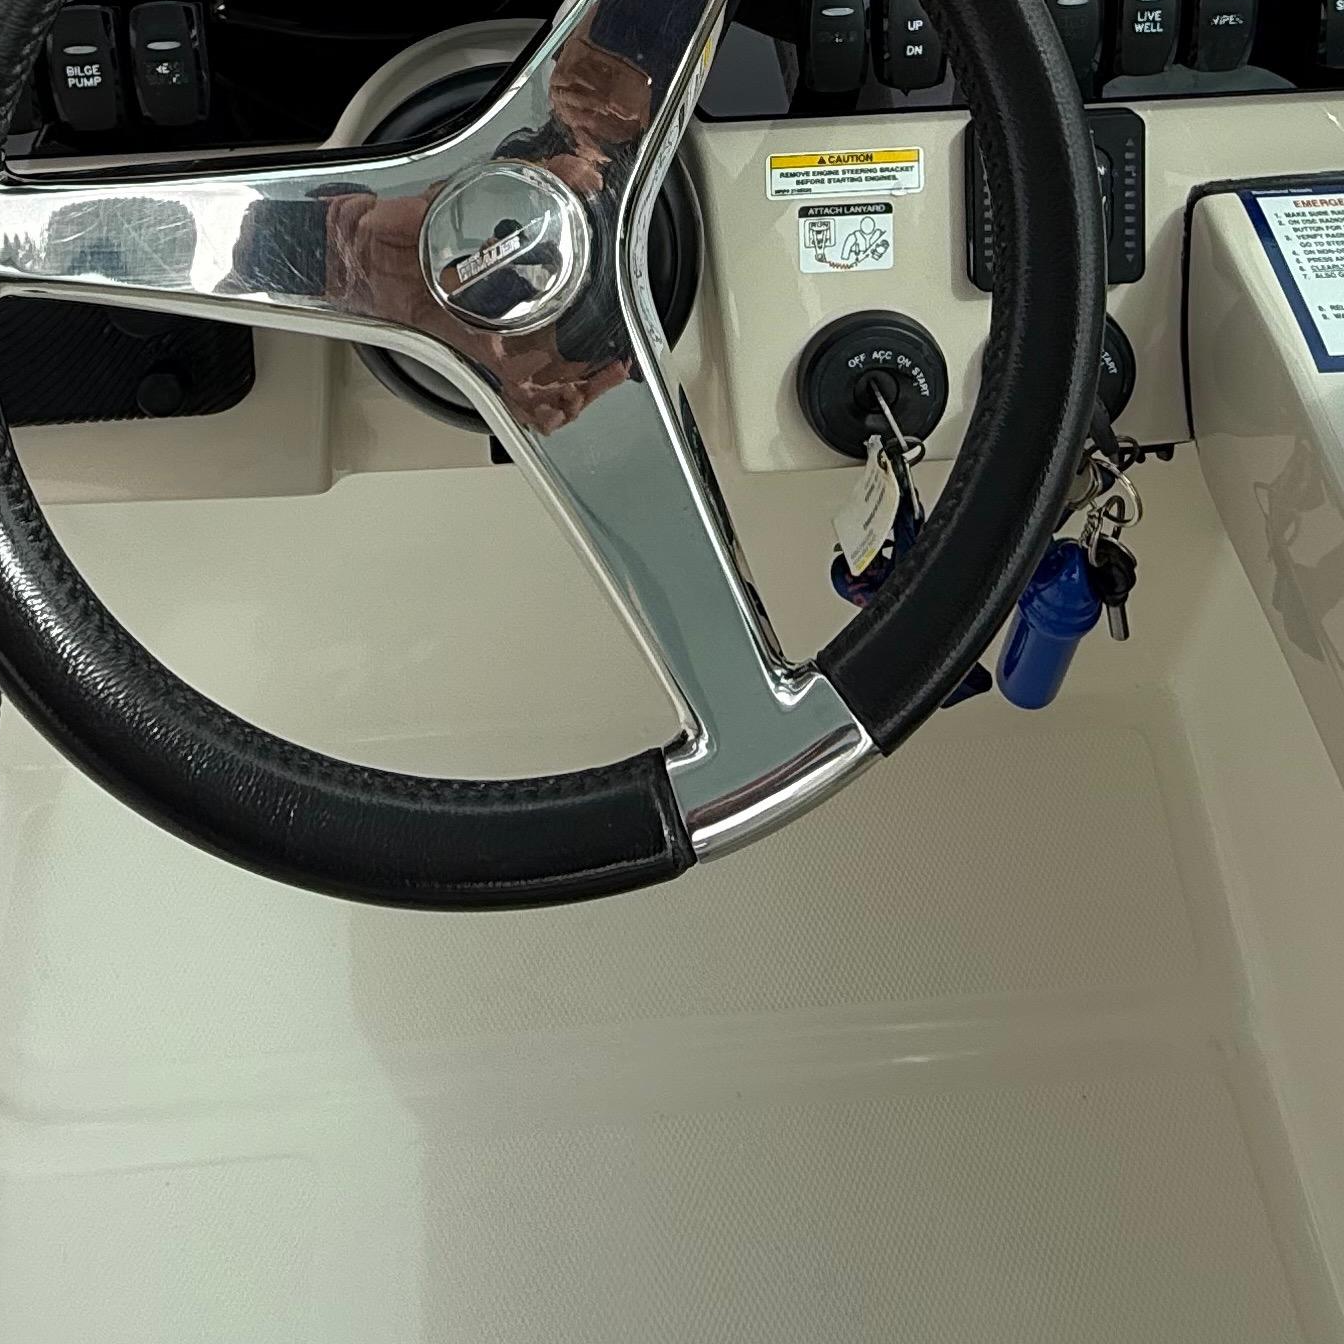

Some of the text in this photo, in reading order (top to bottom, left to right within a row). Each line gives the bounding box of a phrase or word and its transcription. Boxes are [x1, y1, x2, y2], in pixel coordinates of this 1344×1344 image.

[1137, 10, 1162, 22] LIVE
[907, 20, 924, 31] UP
[1134, 22, 1164, 33] WELL
[906, 46, 923, 56] DN
[66, 64, 102, 77] BILGE
[68, 76, 102, 88] PUMP
[828, 154, 874, 164] CAUTION
[842, 168, 878, 176] STEERING
[796, 178, 826, 186] BEFORE
[808, 204, 886, 216] ATTACH LANYARD
[848, 350, 930, 396] OFF ACC ON START
